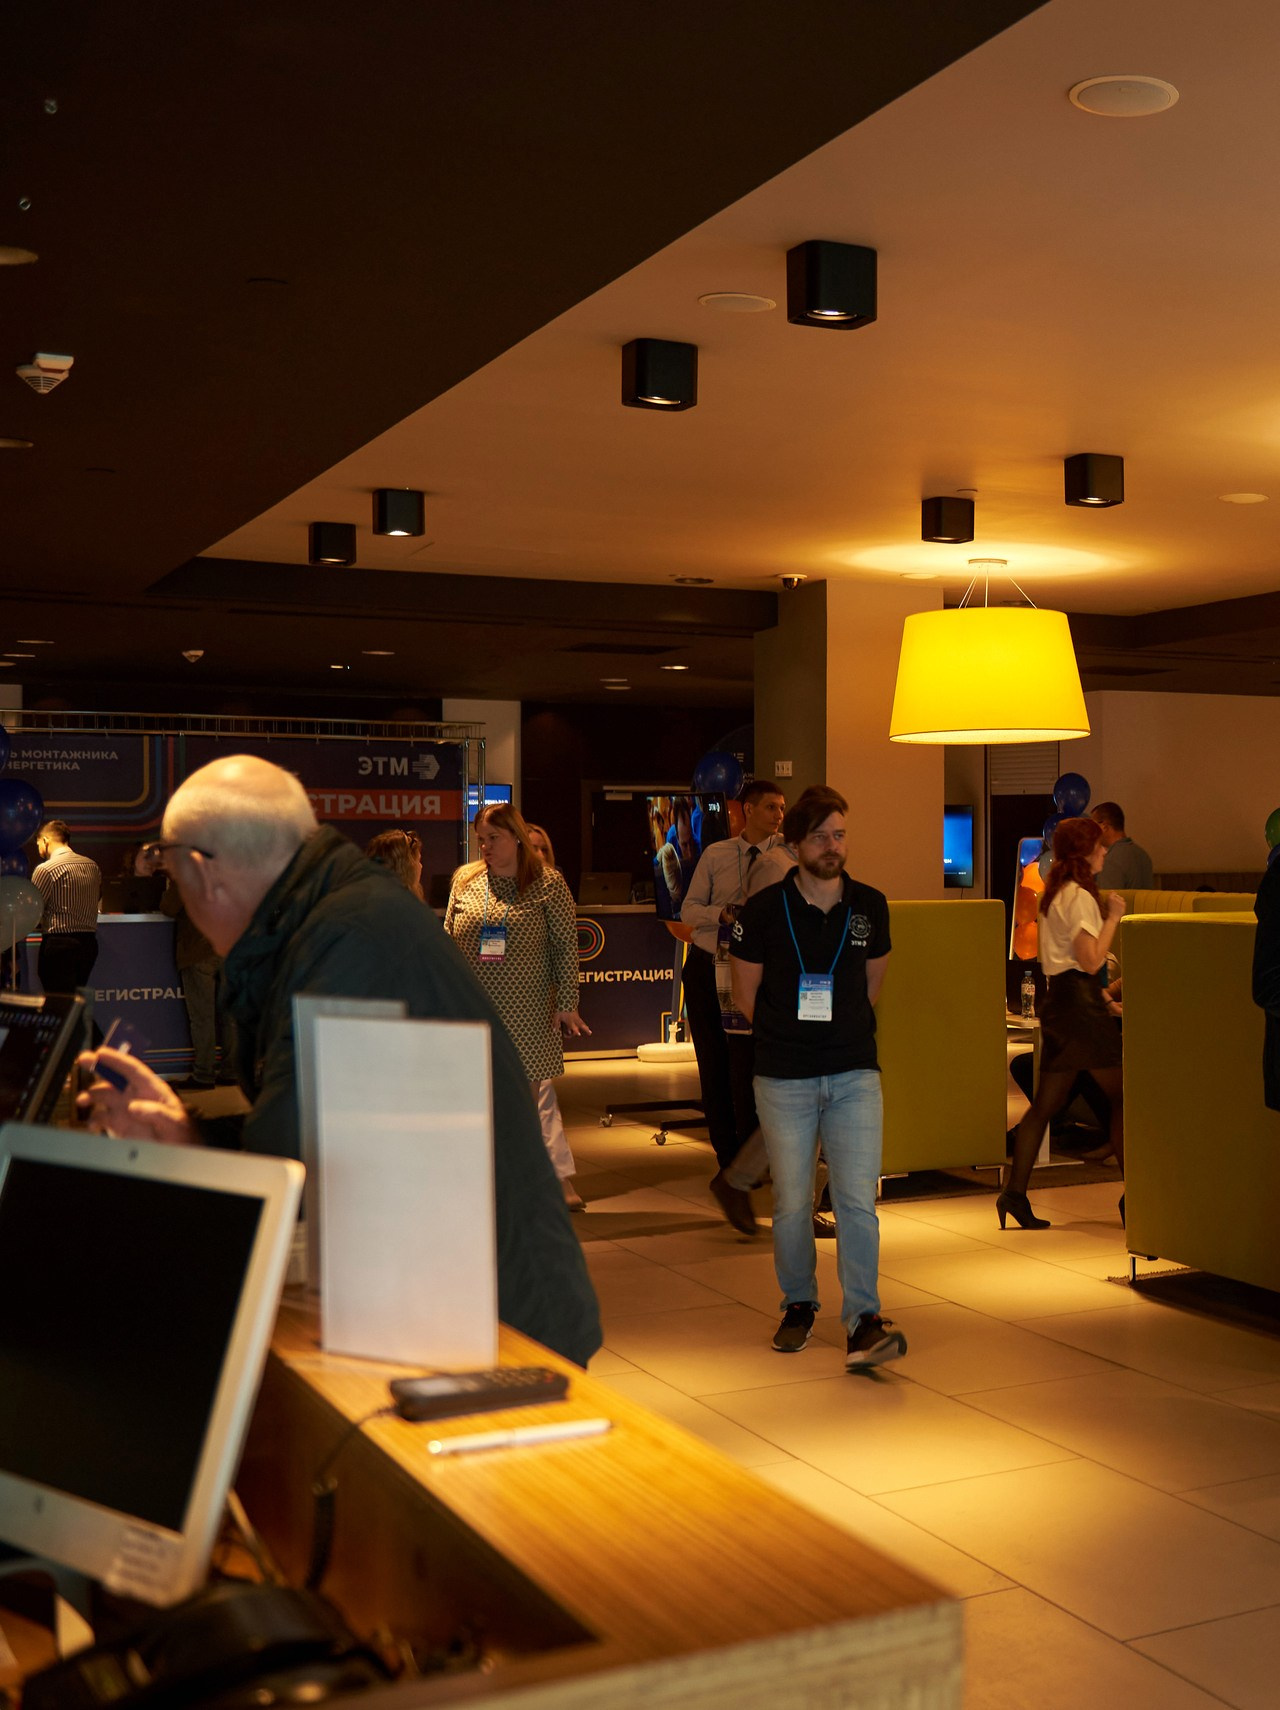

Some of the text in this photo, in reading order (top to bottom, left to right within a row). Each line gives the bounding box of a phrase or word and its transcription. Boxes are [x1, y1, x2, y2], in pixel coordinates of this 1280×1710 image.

[21, 750, 119, 760] МОНТАЖНИКА
[357, 755, 408, 777] ЭТМ
[578, 968, 674, 985] ЕГИСТРАЦИЯ
